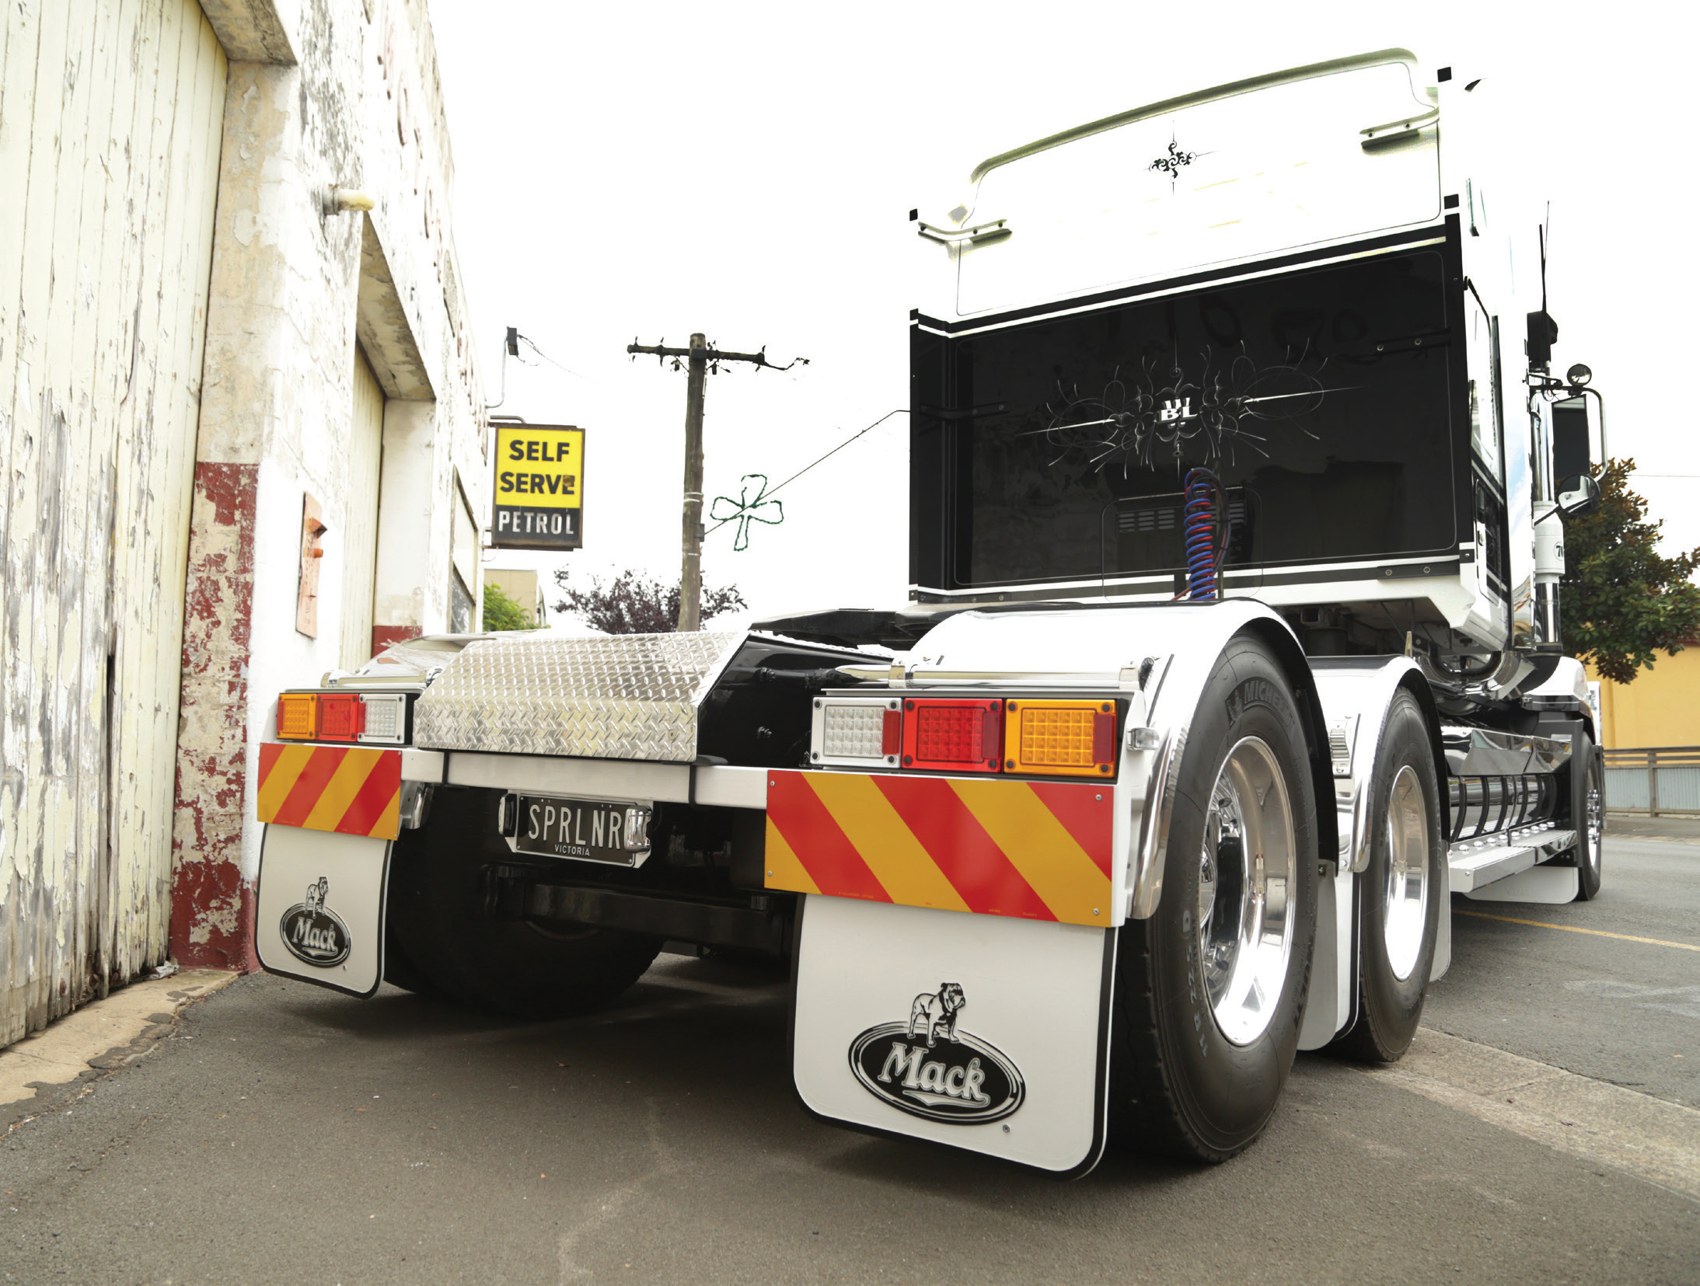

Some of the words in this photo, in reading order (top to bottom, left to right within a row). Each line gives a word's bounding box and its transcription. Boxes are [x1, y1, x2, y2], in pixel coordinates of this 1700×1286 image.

[509, 439, 570, 462] SELF
[499, 471, 576, 495] SERVE
[498, 510, 574, 535] PETROL
[528, 804, 622, 850] SPRLNR
[554, 843, 591, 857] VICTORIA
[292, 916, 338, 953] Mack
[877, 1041, 991, 1104] Mack
